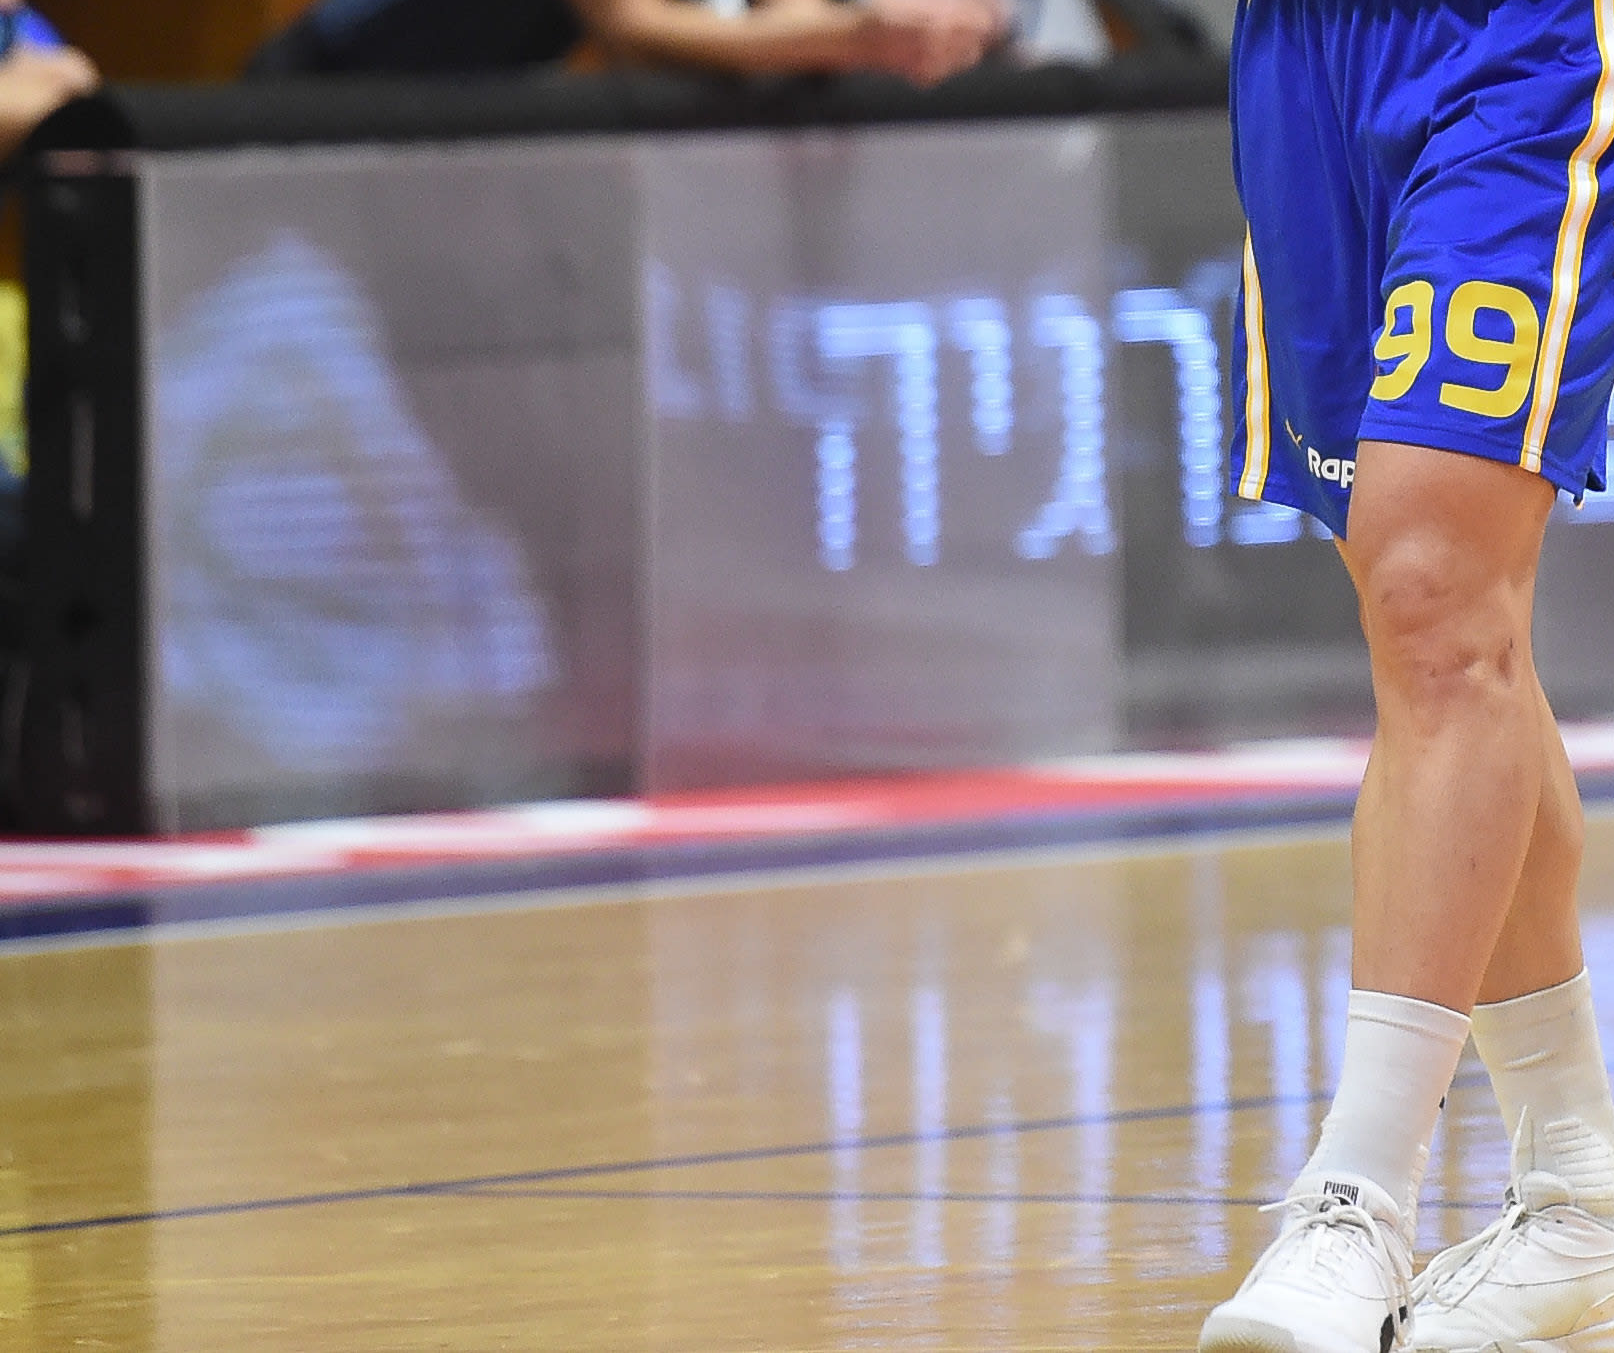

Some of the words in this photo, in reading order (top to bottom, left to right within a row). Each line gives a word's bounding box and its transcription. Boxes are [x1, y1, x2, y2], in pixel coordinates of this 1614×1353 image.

[1369, 280, 1540, 418] 99
[817, 284, 1335, 570] רגיה
[1307, 446, 1356, 489] Rap
[1323, 1180, 1359, 1206] PUMA
